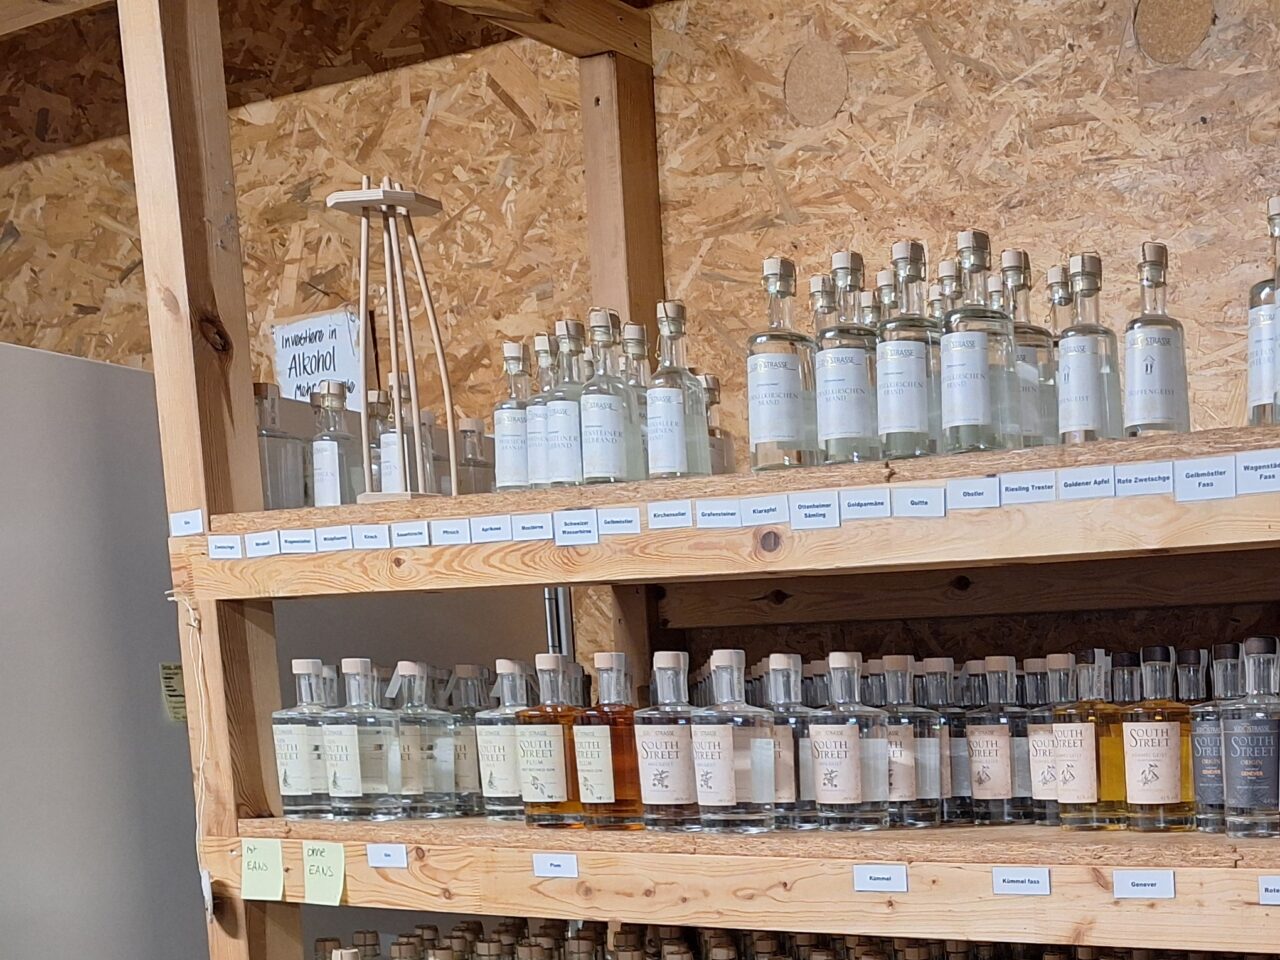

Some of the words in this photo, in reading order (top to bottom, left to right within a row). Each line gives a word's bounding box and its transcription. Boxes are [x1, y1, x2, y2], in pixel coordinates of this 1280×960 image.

[329, 325, 338, 341] in
[288, 346, 337, 379] Alkohol
[1185, 469, 1227, 479] Gelbmöstler
[1260, 473, 1276, 481] Fass
[1063, 479, 1091, 488] Goldener
[1093, 478, 1110, 487] Apfel
[1117, 478, 1132, 486] Rote
[1134, 475, 1171, 485] Zwetschge
[1198, 480, 1214, 488] Fass
[963, 490, 984, 498] Obstler
[1004, 486, 1029, 495] Riesling
[1031, 484, 1054, 492] Trester
[847, 499, 884, 509] Goldparmäne
[910, 499, 929, 508] Quitte
[1002, 877, 1026, 886] Kümmel
[1130, 880, 1157, 889] Genever
[1264, 887, 1280, 895] Rote
